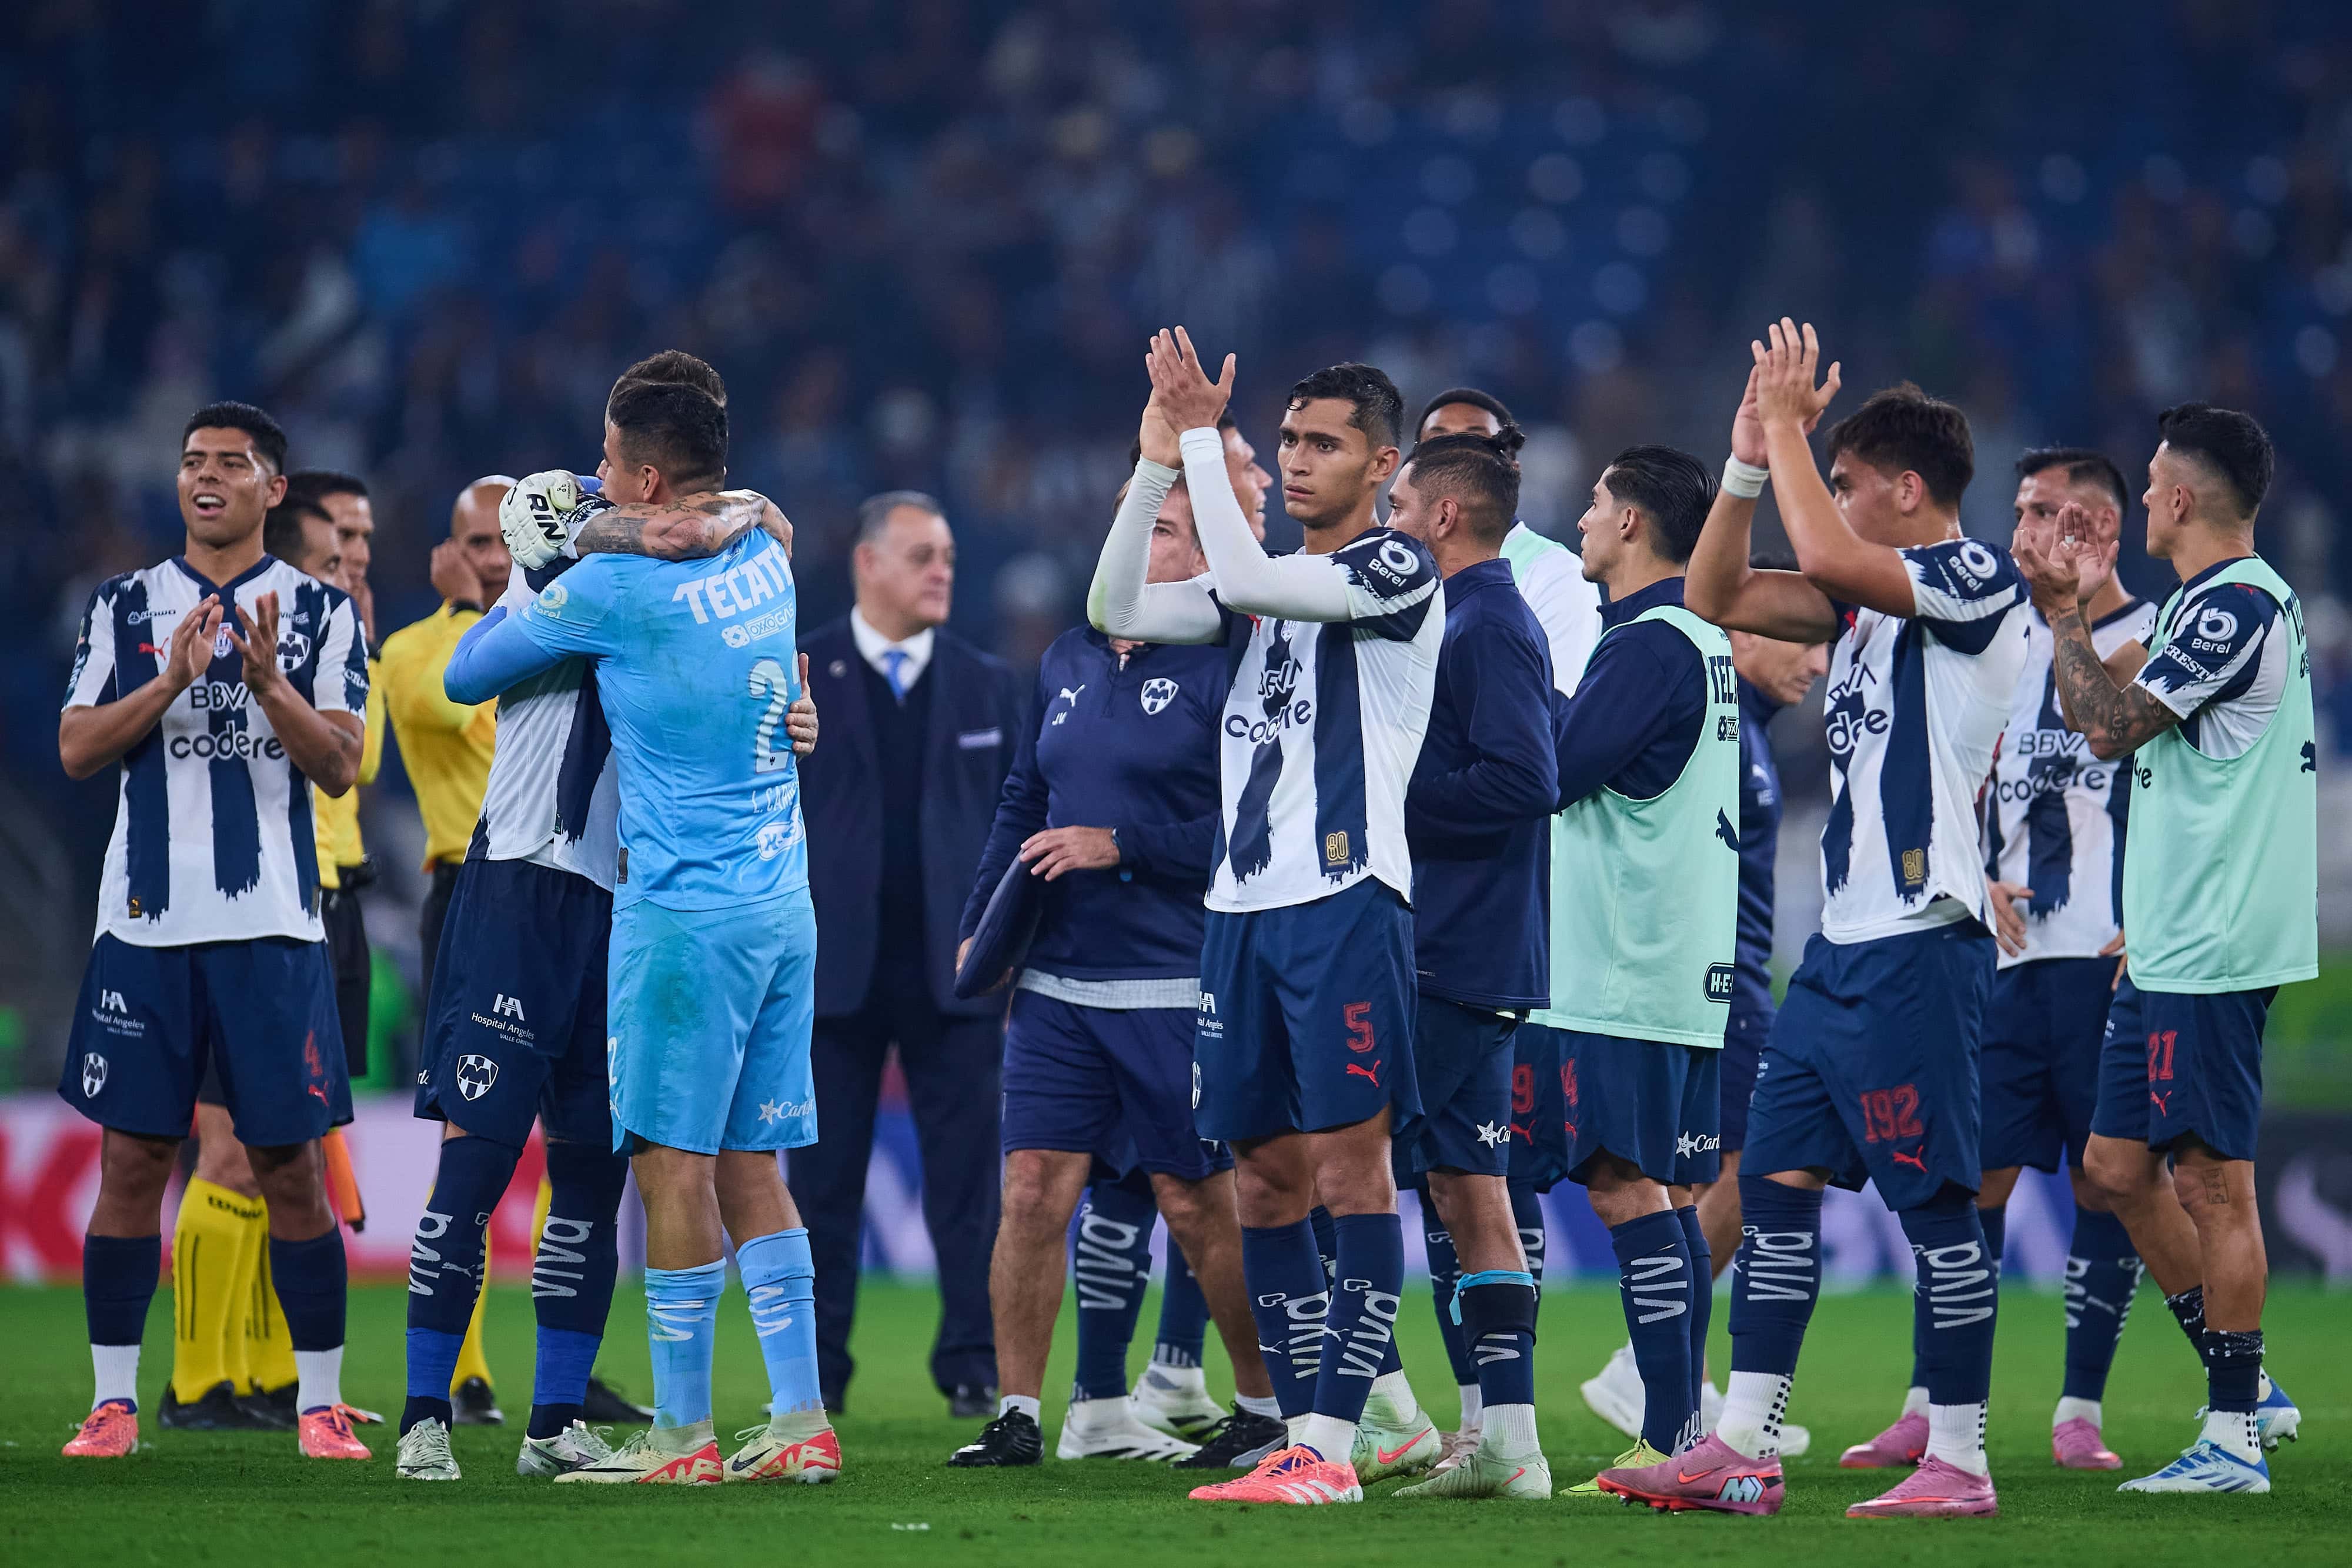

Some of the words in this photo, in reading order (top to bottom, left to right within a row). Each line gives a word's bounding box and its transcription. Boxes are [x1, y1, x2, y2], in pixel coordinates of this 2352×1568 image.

[526, 493, 566, 540] RIN
[1368, 558, 1407, 587] Berel
[2191, 638, 2231, 654] Berel
[1708, 655, 1738, 704] TEC
[169, 720, 286, 761] codere
[1999, 765, 2106, 803] codere
[101, 988, 128, 1014] HA
[112, 1015, 145, 1029] Angeles
[493, 993, 525, 1021] HA
[471, 1012, 507, 1031] Hospital
[507, 1024, 534, 1040] Angeles
[500, 1033, 516, 1042] VALLE
[1343, 1001, 1375, 1054] 5
[2147, 1030, 2177, 1082] 21
[1859, 1083, 1925, 1144] 192
[409, 1208, 453, 1296] viva
[532, 1215, 593, 1298] viva
[1076, 1213, 1140, 1310] viva
[1747, 1231, 1815, 1301] viva
[1630, 1243, 1688, 1325] viv
[1923, 1240, 1994, 1329] viva
[1337, 1290, 1401, 1379] viva
